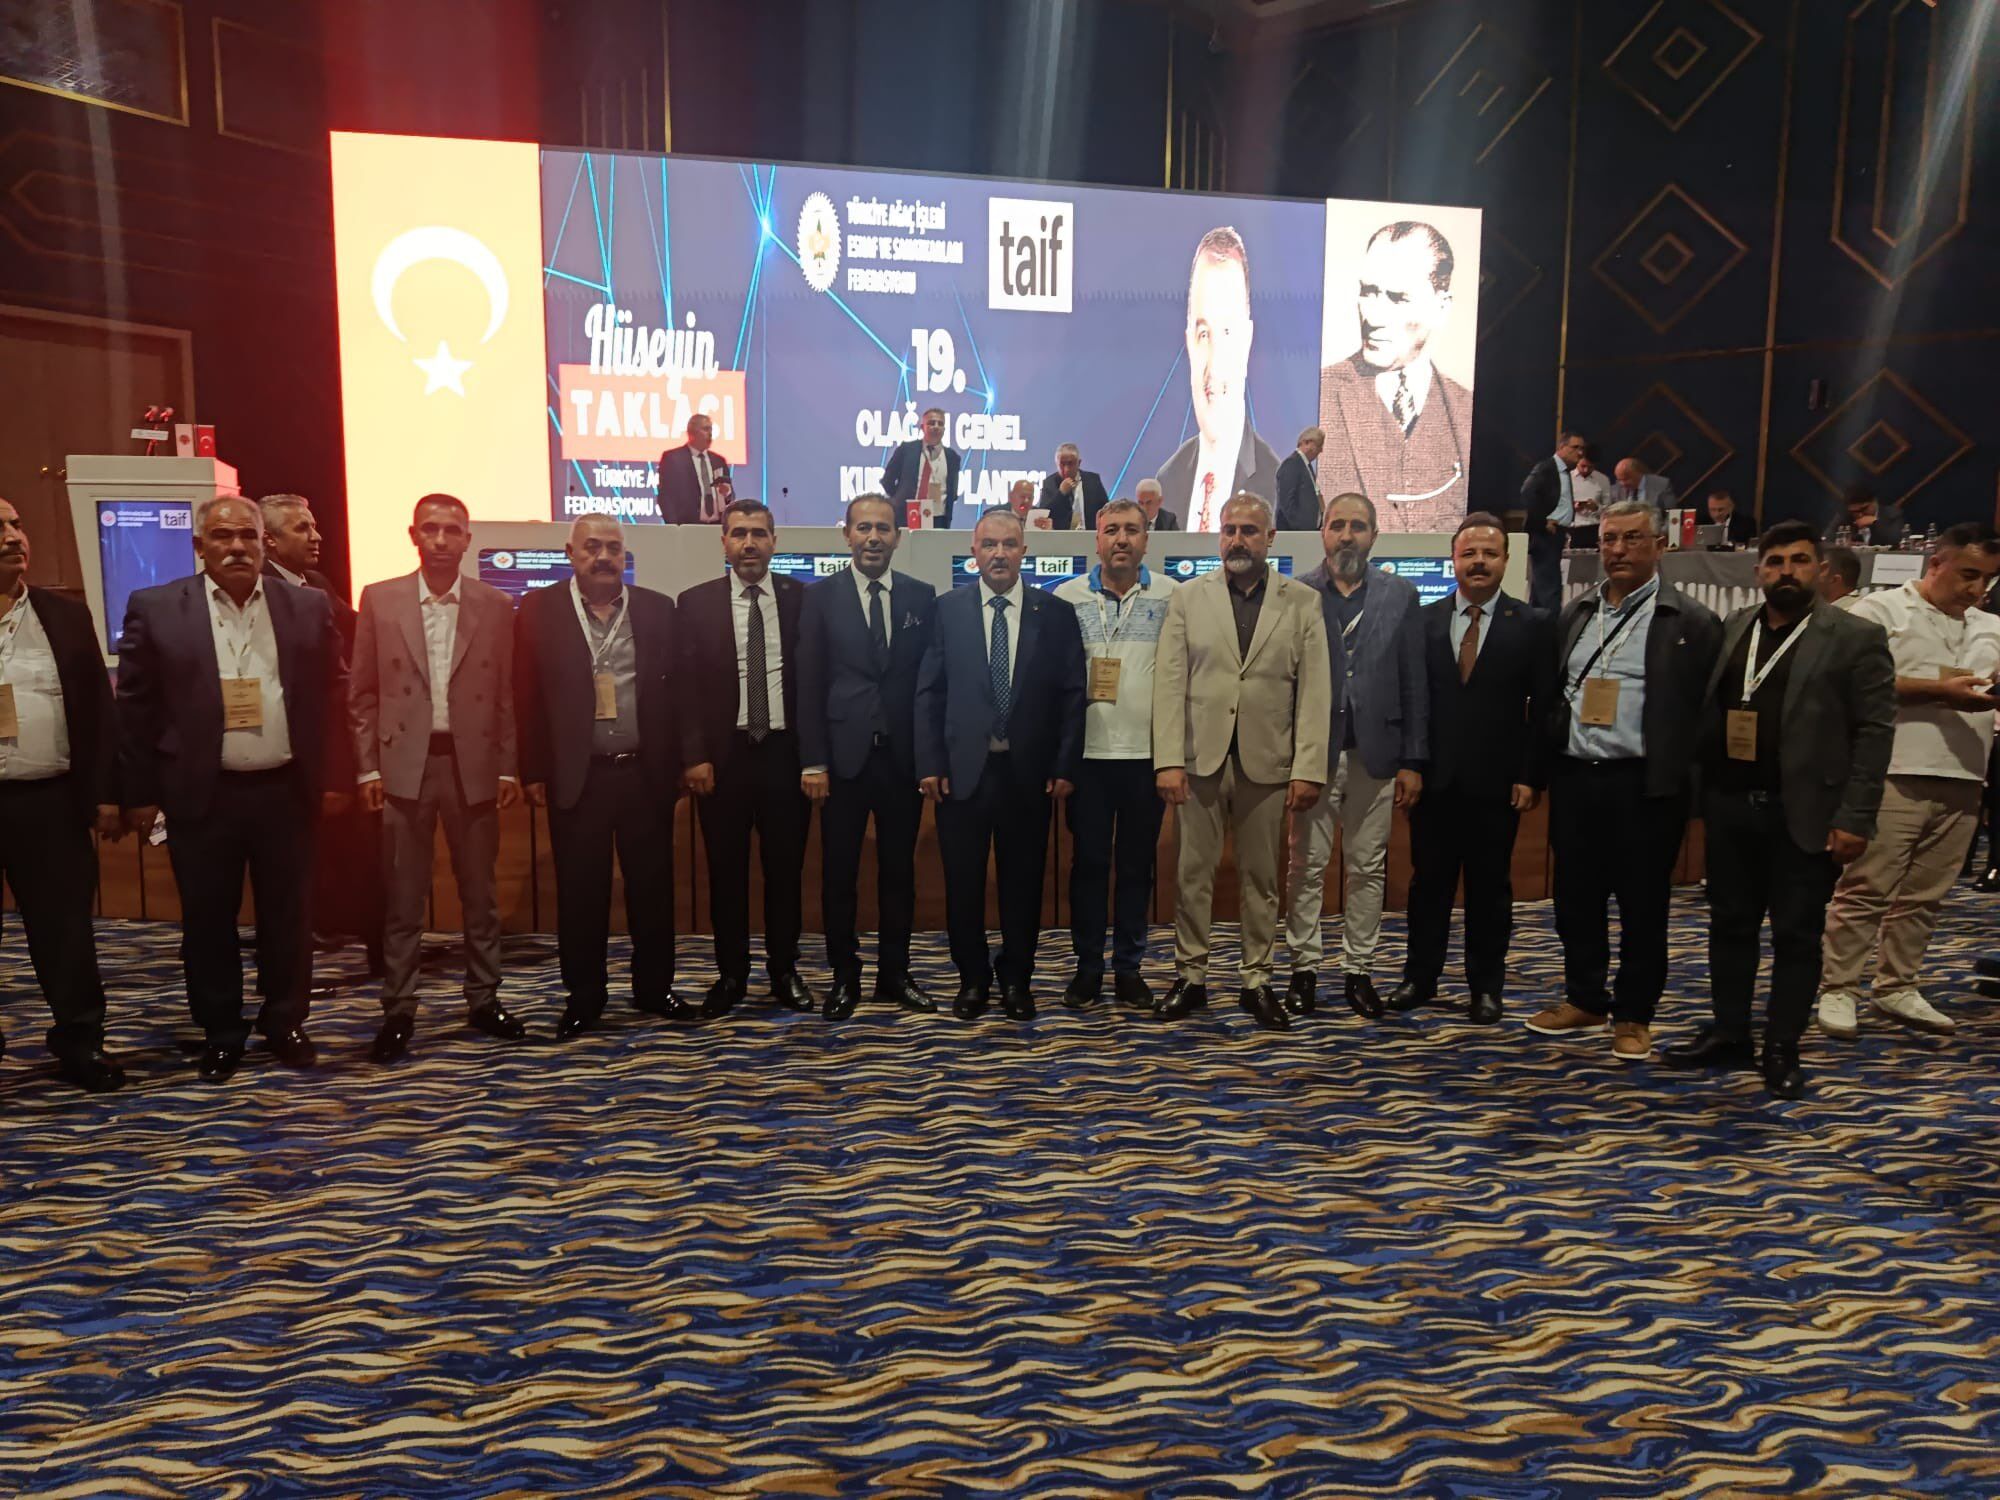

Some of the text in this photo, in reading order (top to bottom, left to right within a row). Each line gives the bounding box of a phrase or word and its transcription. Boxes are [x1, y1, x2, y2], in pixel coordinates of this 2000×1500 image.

[1000, 215, 1064, 297] taif
[584, 304, 720, 398] Hüseyin
[911, 328, 966, 393] 19.
[856, 401, 1027, 451] OLAĞ GENEL
[592, 465, 646, 488] TÜRKİYE
[164, 512, 187, 526] taif
[564, 496, 654, 516] FEDERASYONU
[1040, 559, 1069, 573] taif
